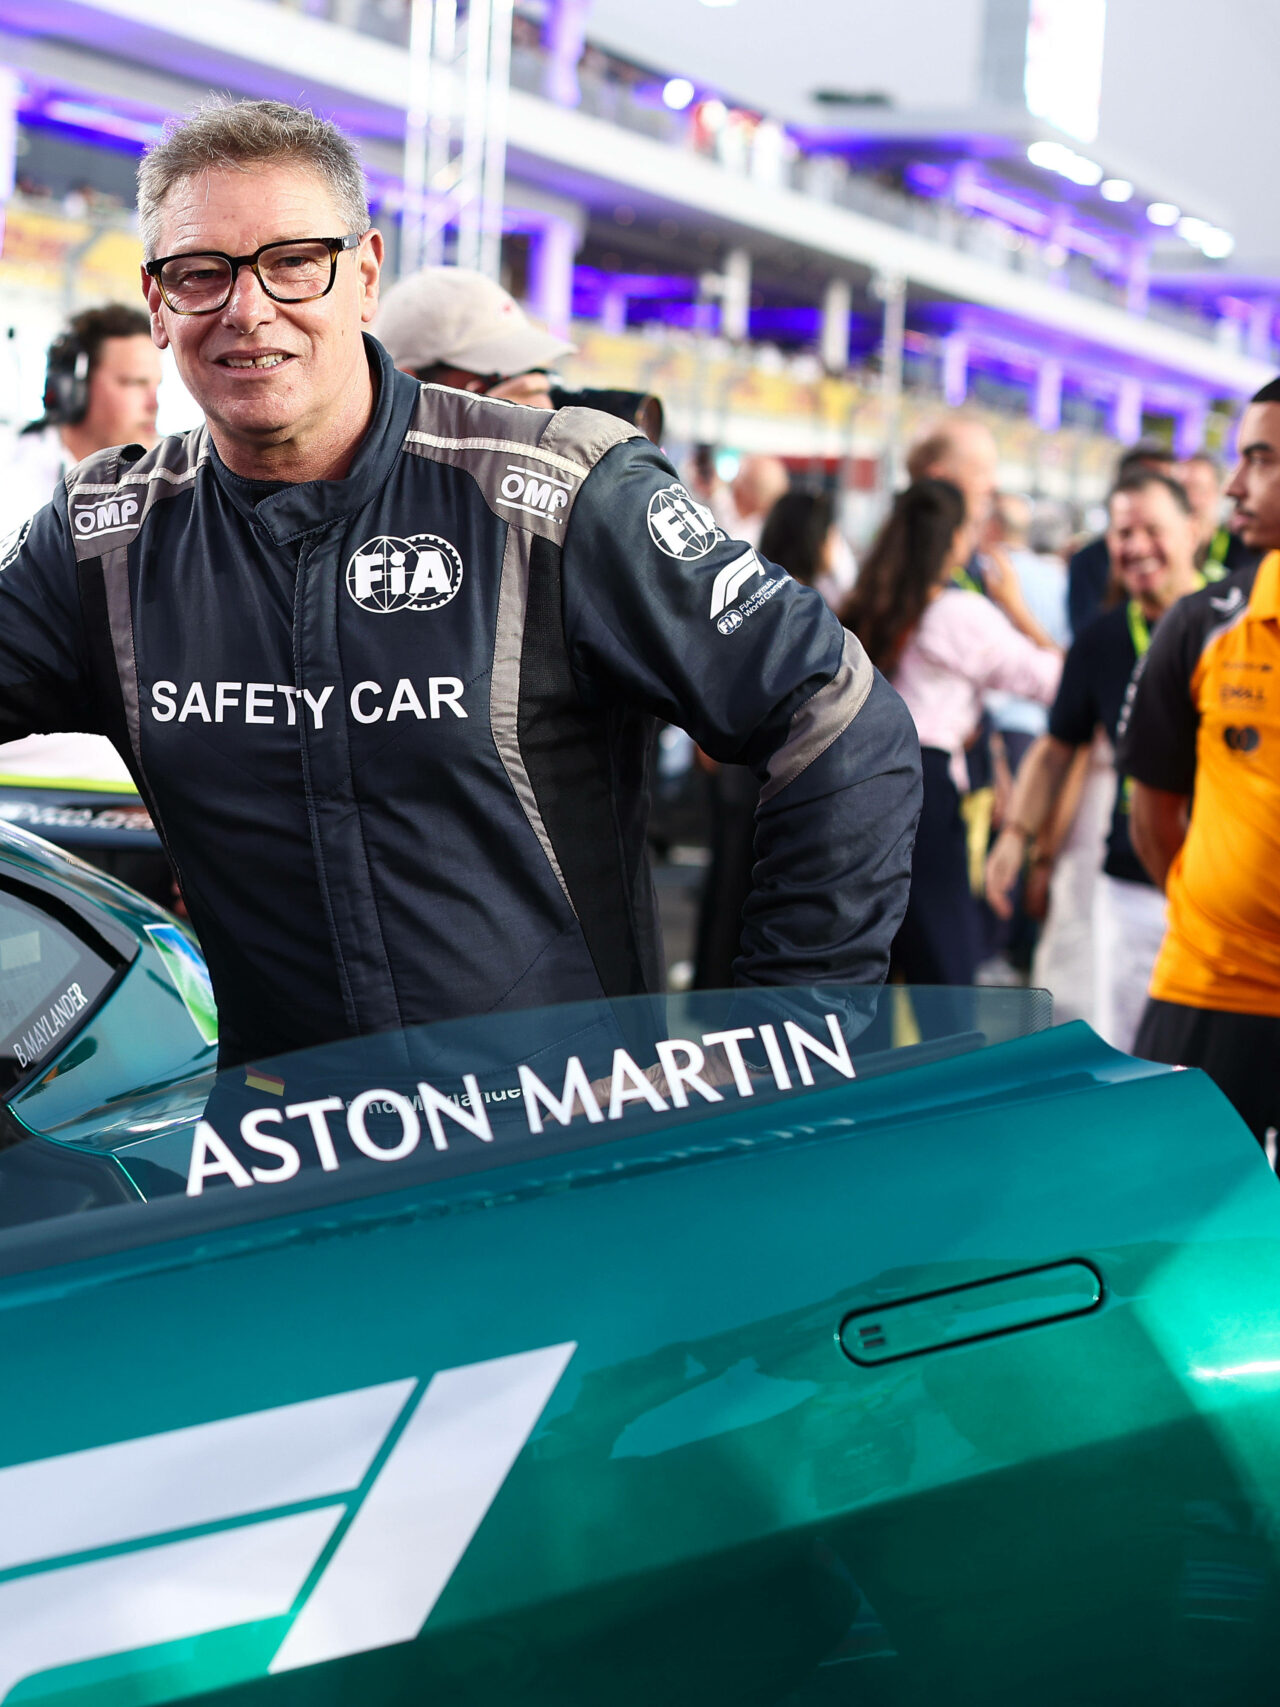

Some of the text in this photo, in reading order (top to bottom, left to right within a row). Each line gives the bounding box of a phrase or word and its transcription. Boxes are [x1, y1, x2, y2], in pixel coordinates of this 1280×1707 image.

[500, 472, 568, 513] OMP
[74, 499, 139, 534] OMP
[743, 599, 766, 617] World
[150, 675, 469, 729] SAFETY CAR
[13, 982, 89, 1068] B.MAYLANDER
[186, 1013, 856, 1197] ASTON MARTIN
